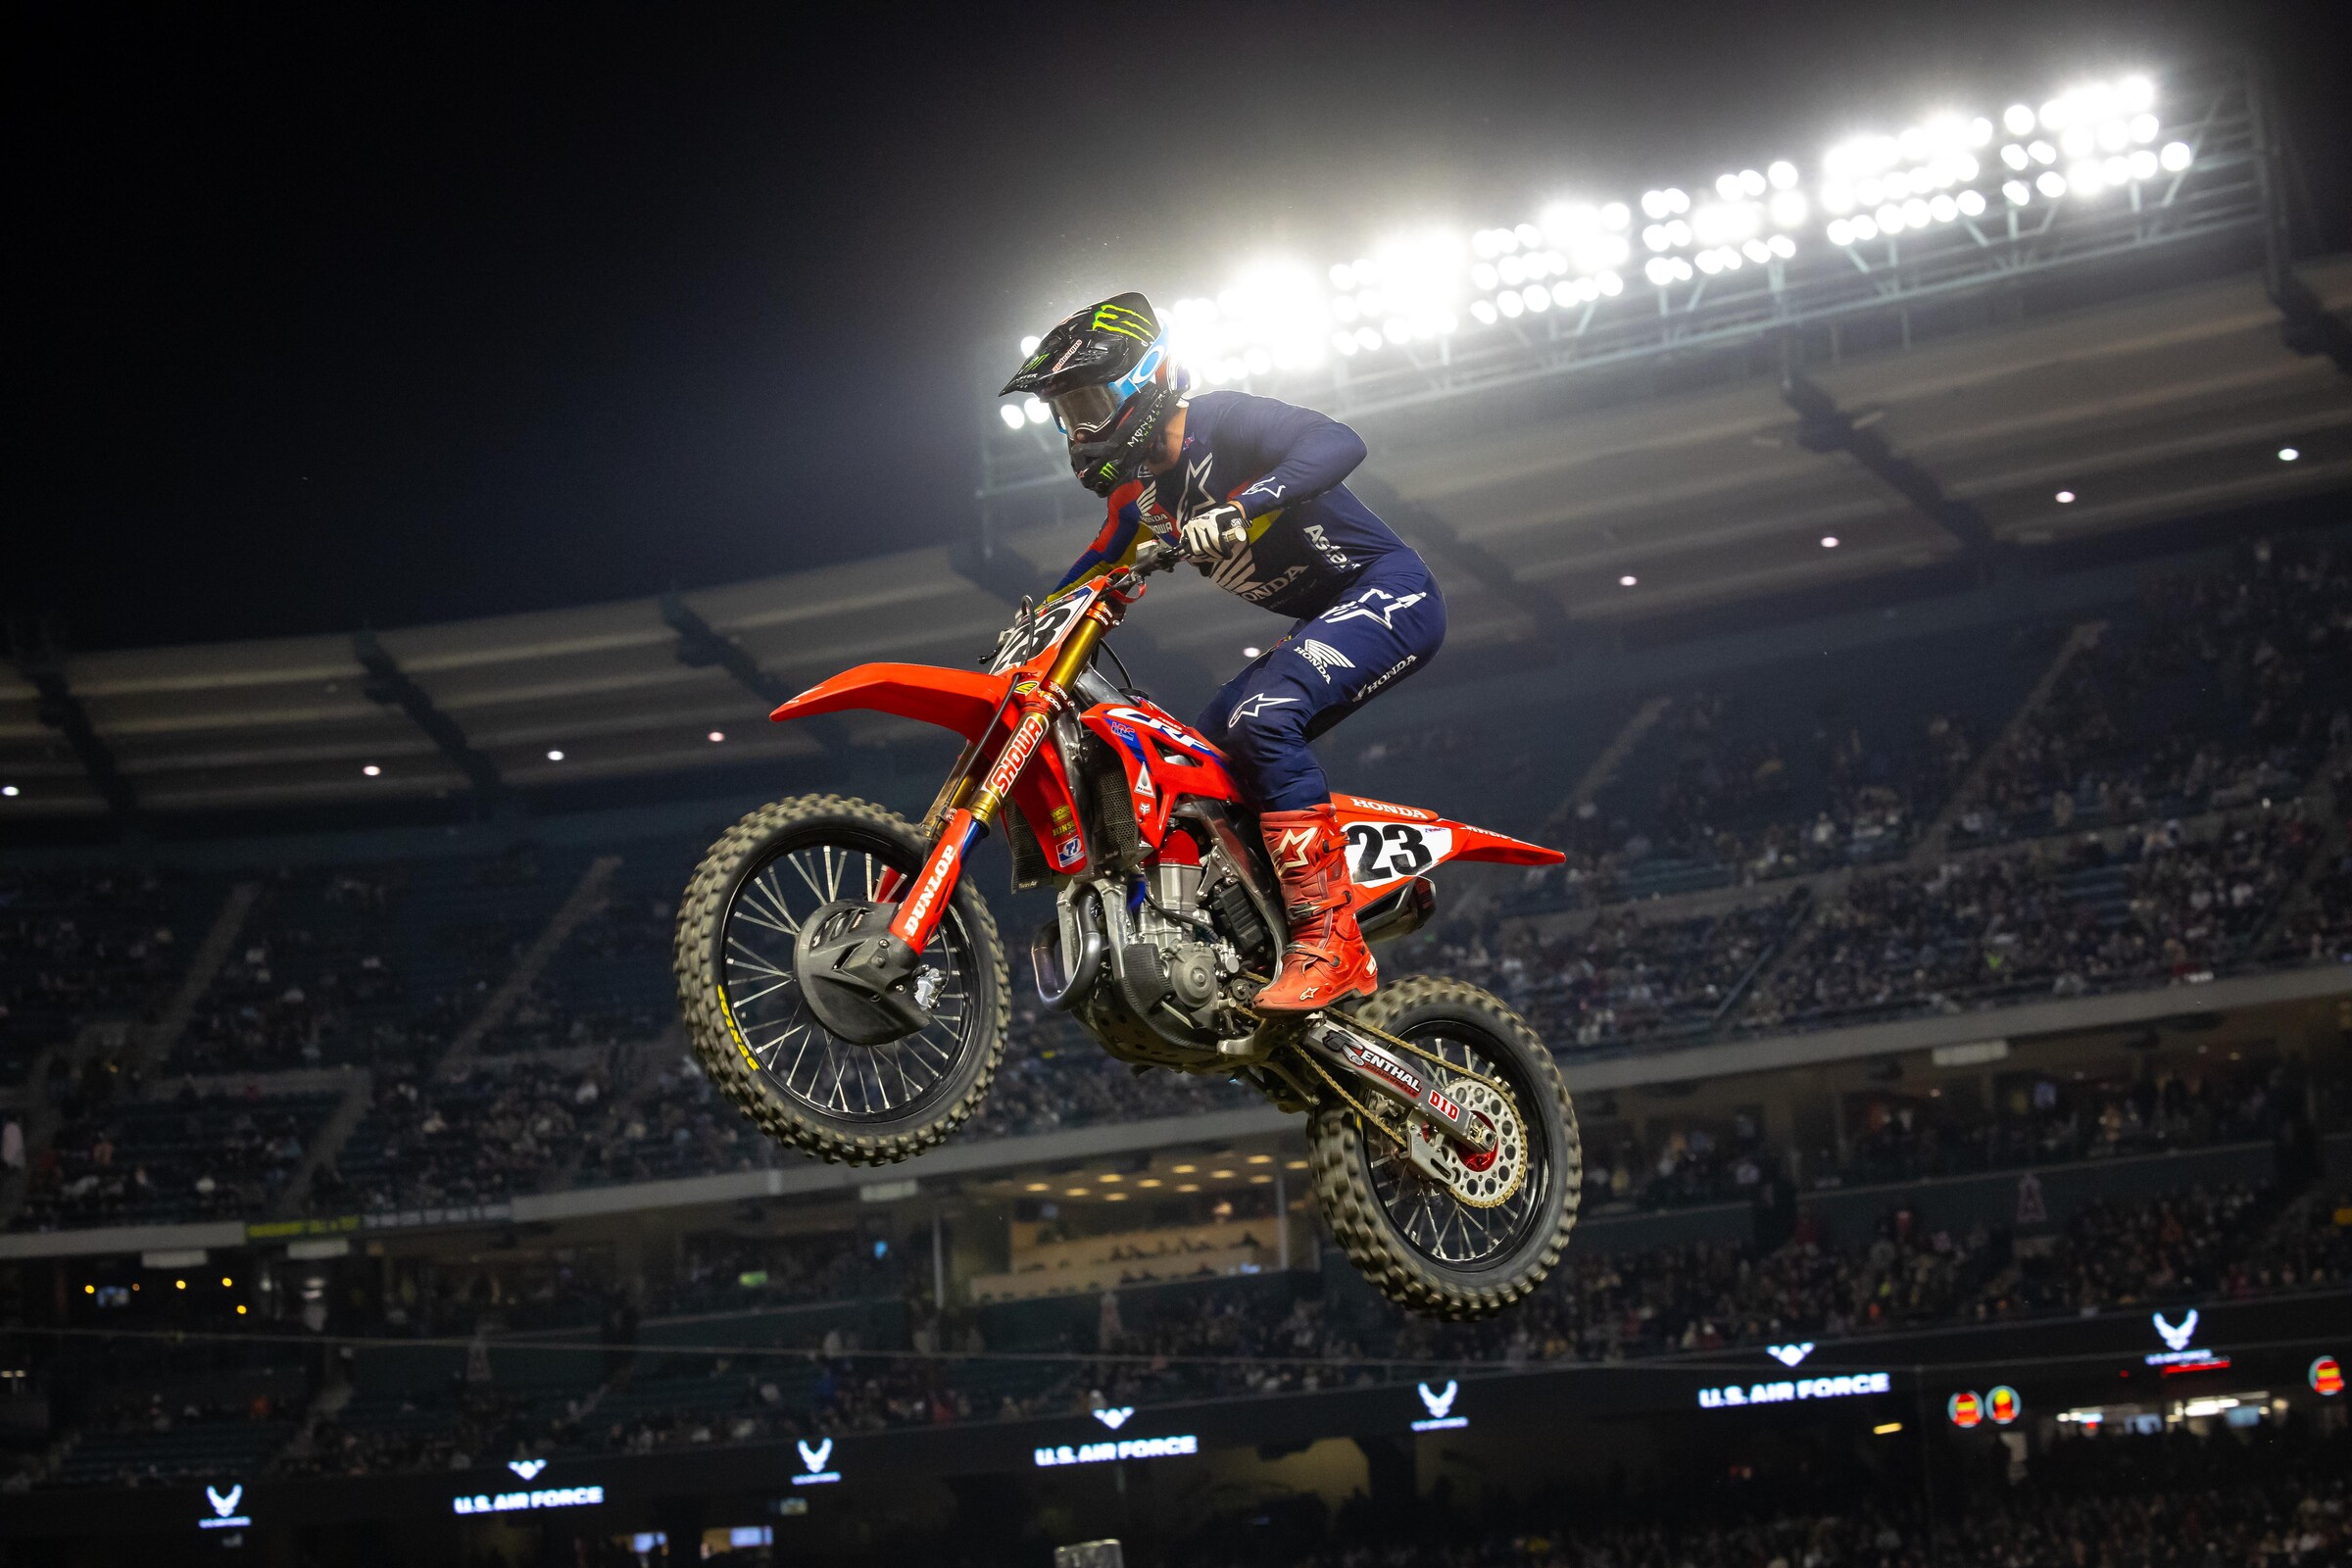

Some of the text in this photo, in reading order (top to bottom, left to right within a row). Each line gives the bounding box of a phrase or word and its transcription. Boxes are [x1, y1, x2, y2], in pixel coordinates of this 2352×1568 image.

[1294, 646, 1332, 684] HONDA
[1366, 654, 1417, 695] HONDA
[1104, 708, 1211, 752] CRF
[991, 716, 1044, 798] SHOWA
[1350, 798, 1428, 820] HONDA
[1347, 823, 1433, 884] 23
[904, 844, 955, 937] DUNLOP
[1698, 1373, 1889, 1407] U.S. AIR FORCE
[1035, 1435, 1198, 1466] U.S. AIR FORCE
[454, 1486, 604, 1513] U.S. AIR FORCE
